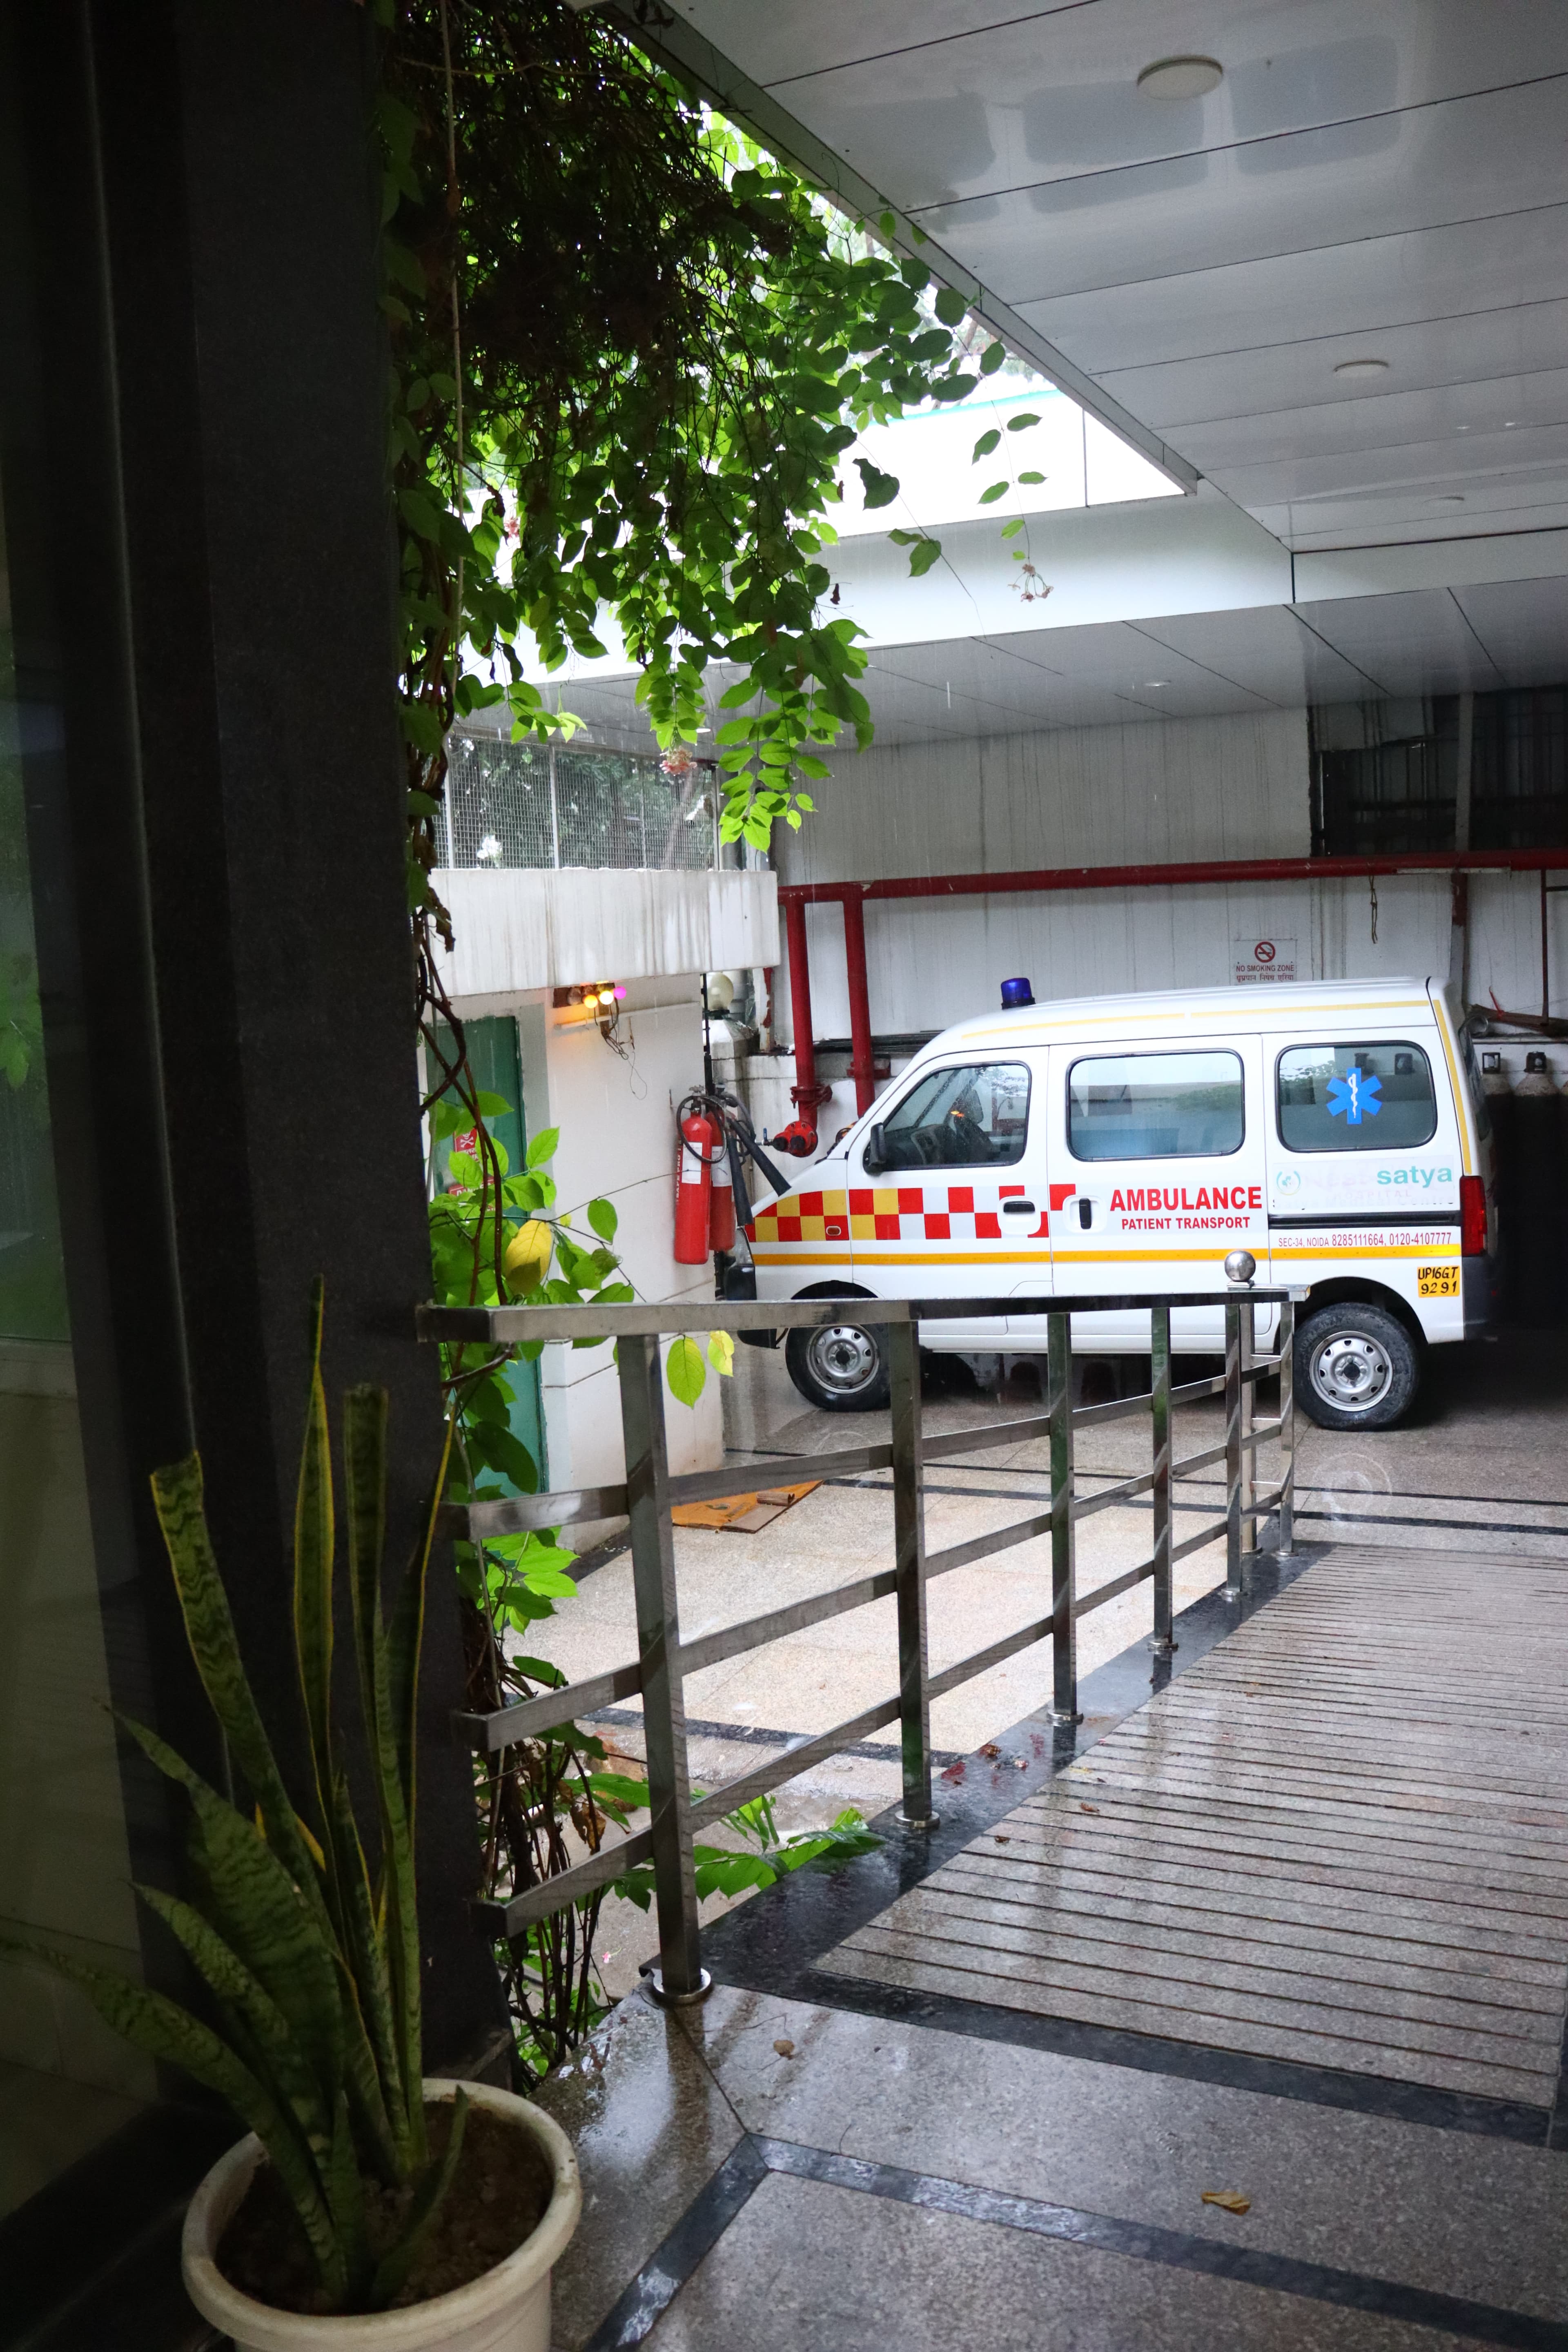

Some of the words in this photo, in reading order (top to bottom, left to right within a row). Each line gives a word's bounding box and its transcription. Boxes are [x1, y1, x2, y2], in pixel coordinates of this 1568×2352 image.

[1377, 1165, 1453, 1189] satya
[1110, 1186, 1262, 1211] AMBULANCE
[1122, 1218, 1172, 1230] PATIENT
[1176, 1217, 1250, 1229] TRANSPORT
[1278, 1238, 1305, 1248] SEC-34,
[1307, 1237, 1330, 1246] NOIDA
[1332, 1233, 1386, 1247] 8285111664,
[1390, 1232, 1451, 1245] 0120-4107777
[1418, 1267, 1459, 1280] UP16GT
[1421, 1281, 1457, 1294] 9291
